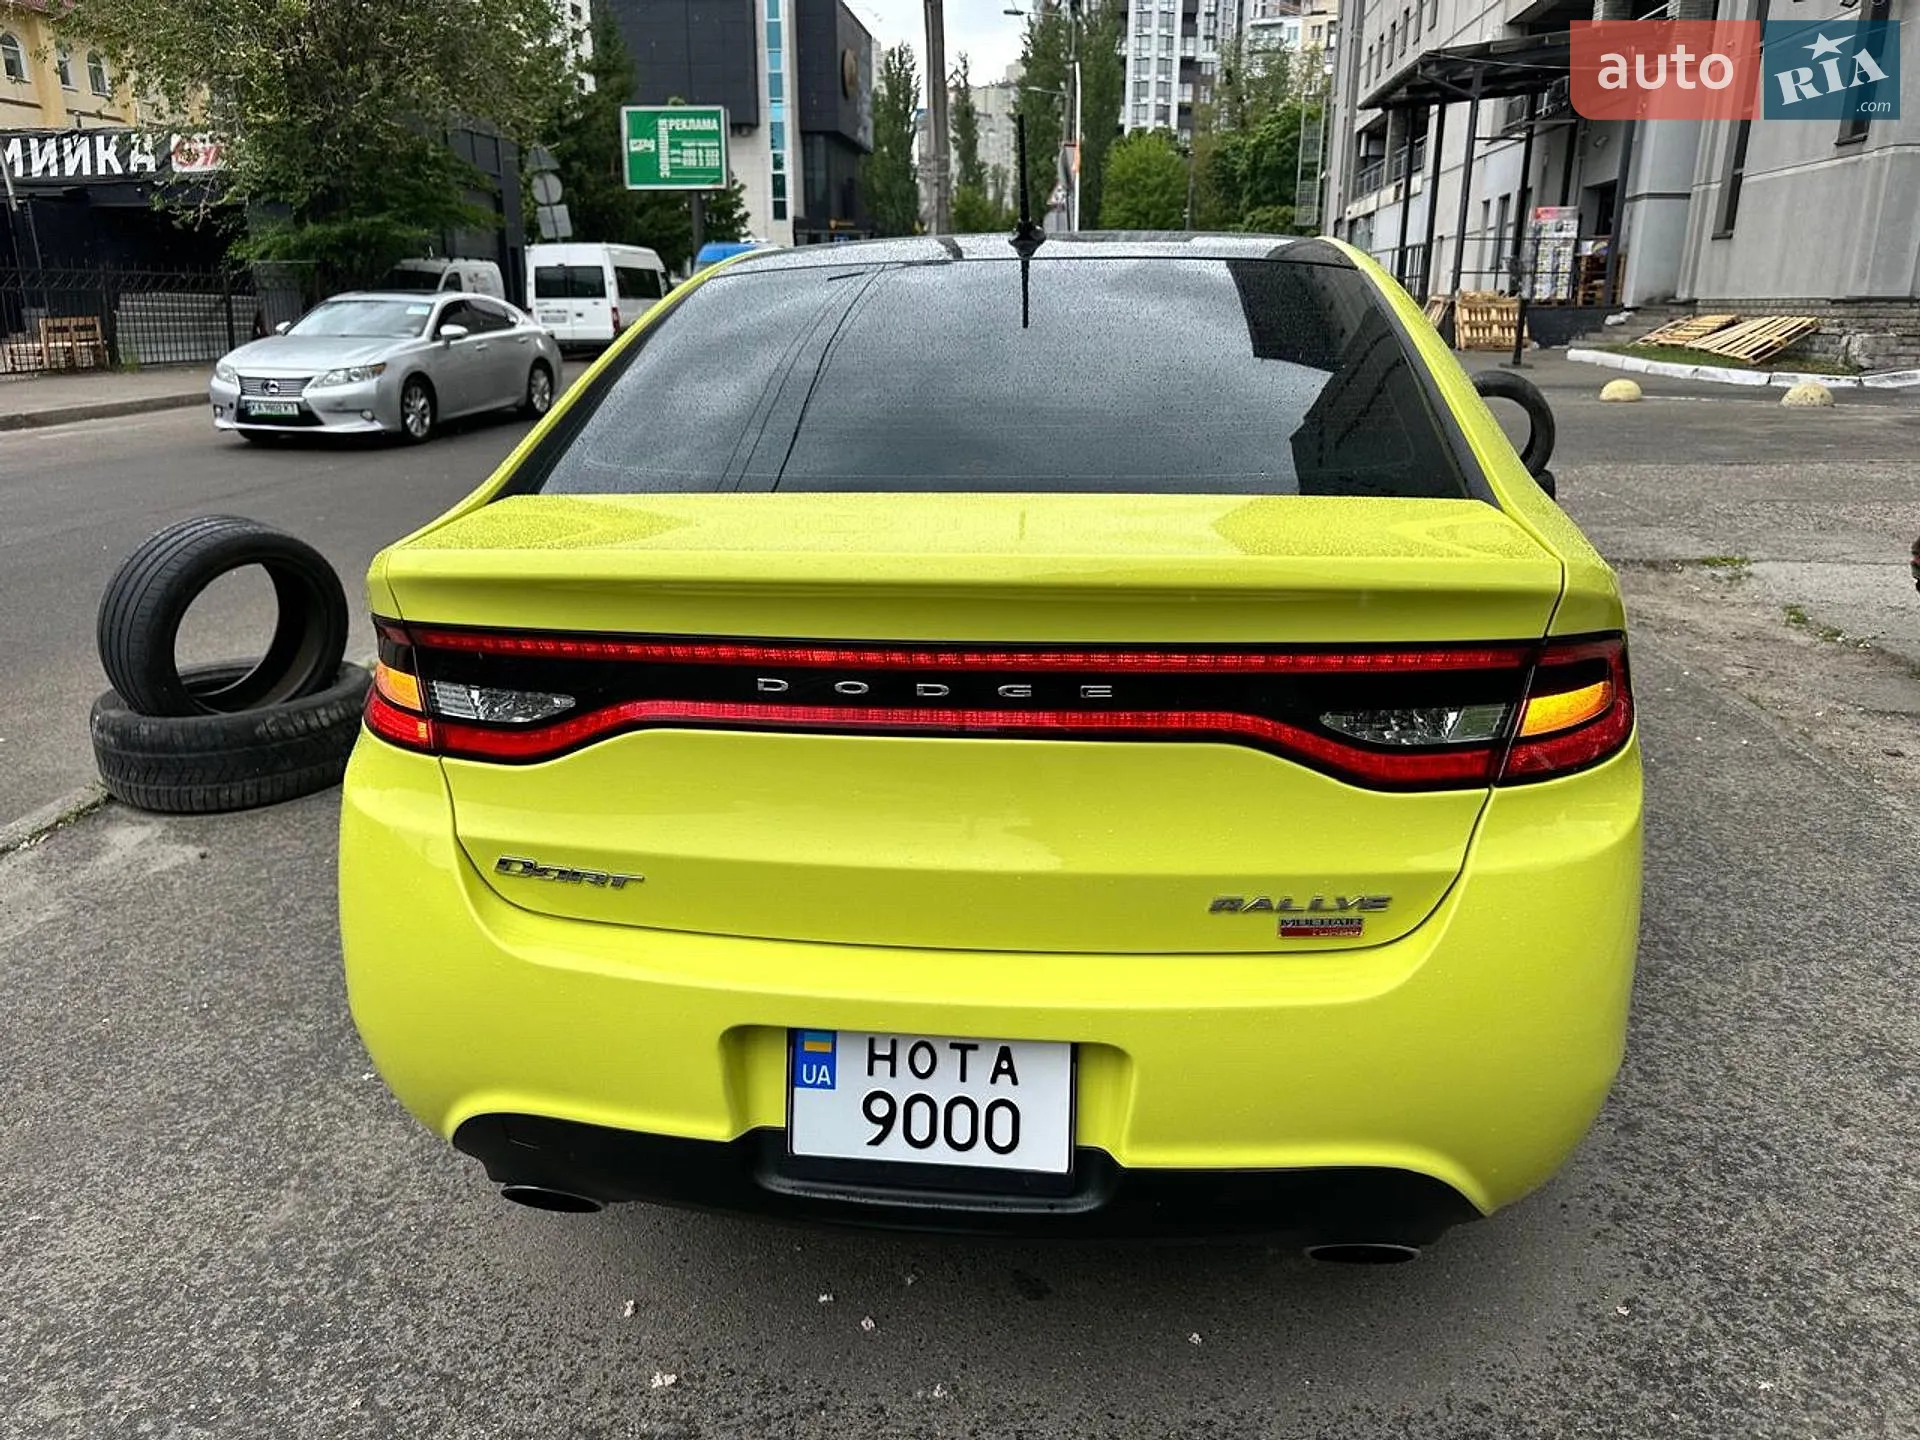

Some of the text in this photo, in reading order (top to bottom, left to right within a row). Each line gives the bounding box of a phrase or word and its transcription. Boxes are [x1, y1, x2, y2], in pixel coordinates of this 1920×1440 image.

[668, 118, 720, 131] РЕКЛАМА
[757, 677, 1113, 699] DODGE
[1208, 896, 1393, 913] RALLYE
[867, 1036, 1019, 1086] HOTA
[802, 1063, 831, 1085] UA
[862, 1090, 1021, 1155] 9000
